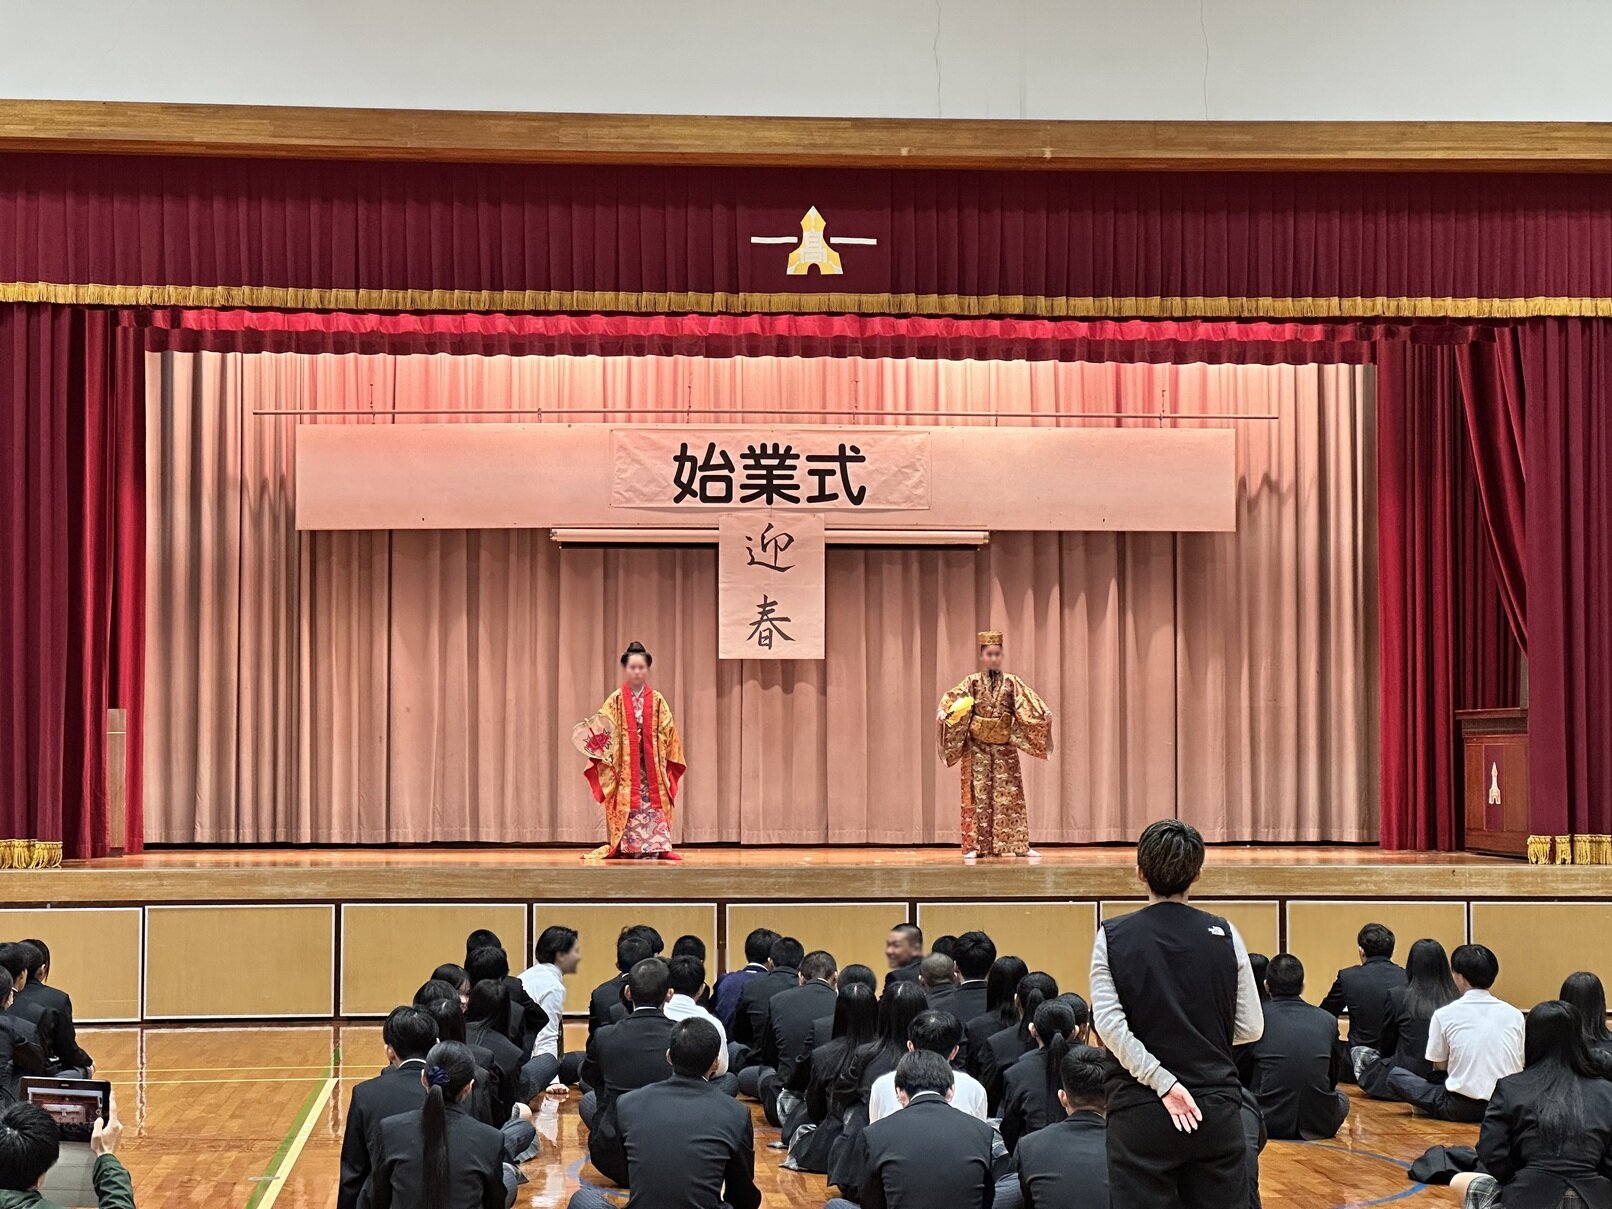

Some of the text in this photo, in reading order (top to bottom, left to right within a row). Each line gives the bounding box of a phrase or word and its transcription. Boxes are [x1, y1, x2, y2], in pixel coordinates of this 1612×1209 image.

[673, 442, 867, 506] 始業式
[744, 522, 796, 650] 迎春
